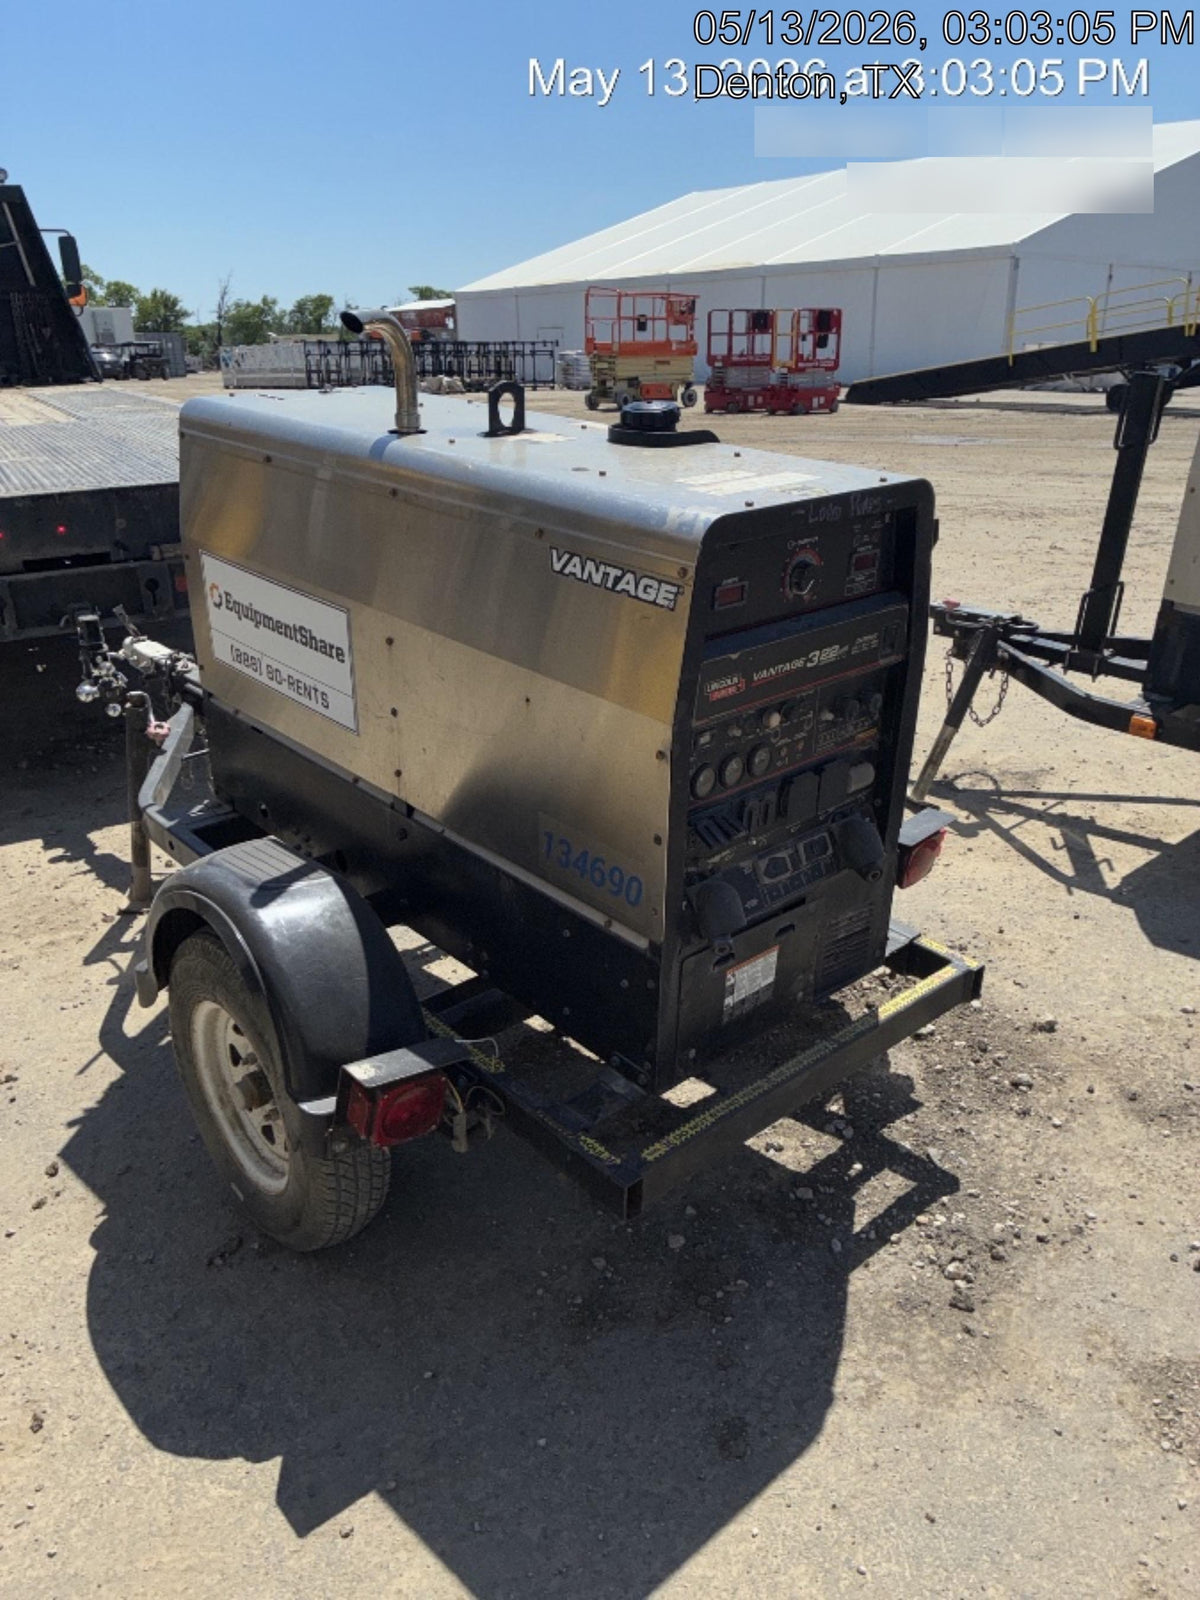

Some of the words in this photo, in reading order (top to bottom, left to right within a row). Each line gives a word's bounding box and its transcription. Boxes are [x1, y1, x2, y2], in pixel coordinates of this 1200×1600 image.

[549, 547, 679, 612] VANTAGE
[223, 590, 346, 664] EquipmentShare
[230, 644, 263, 677] (888)
[543, 829, 644, 908] 134690
